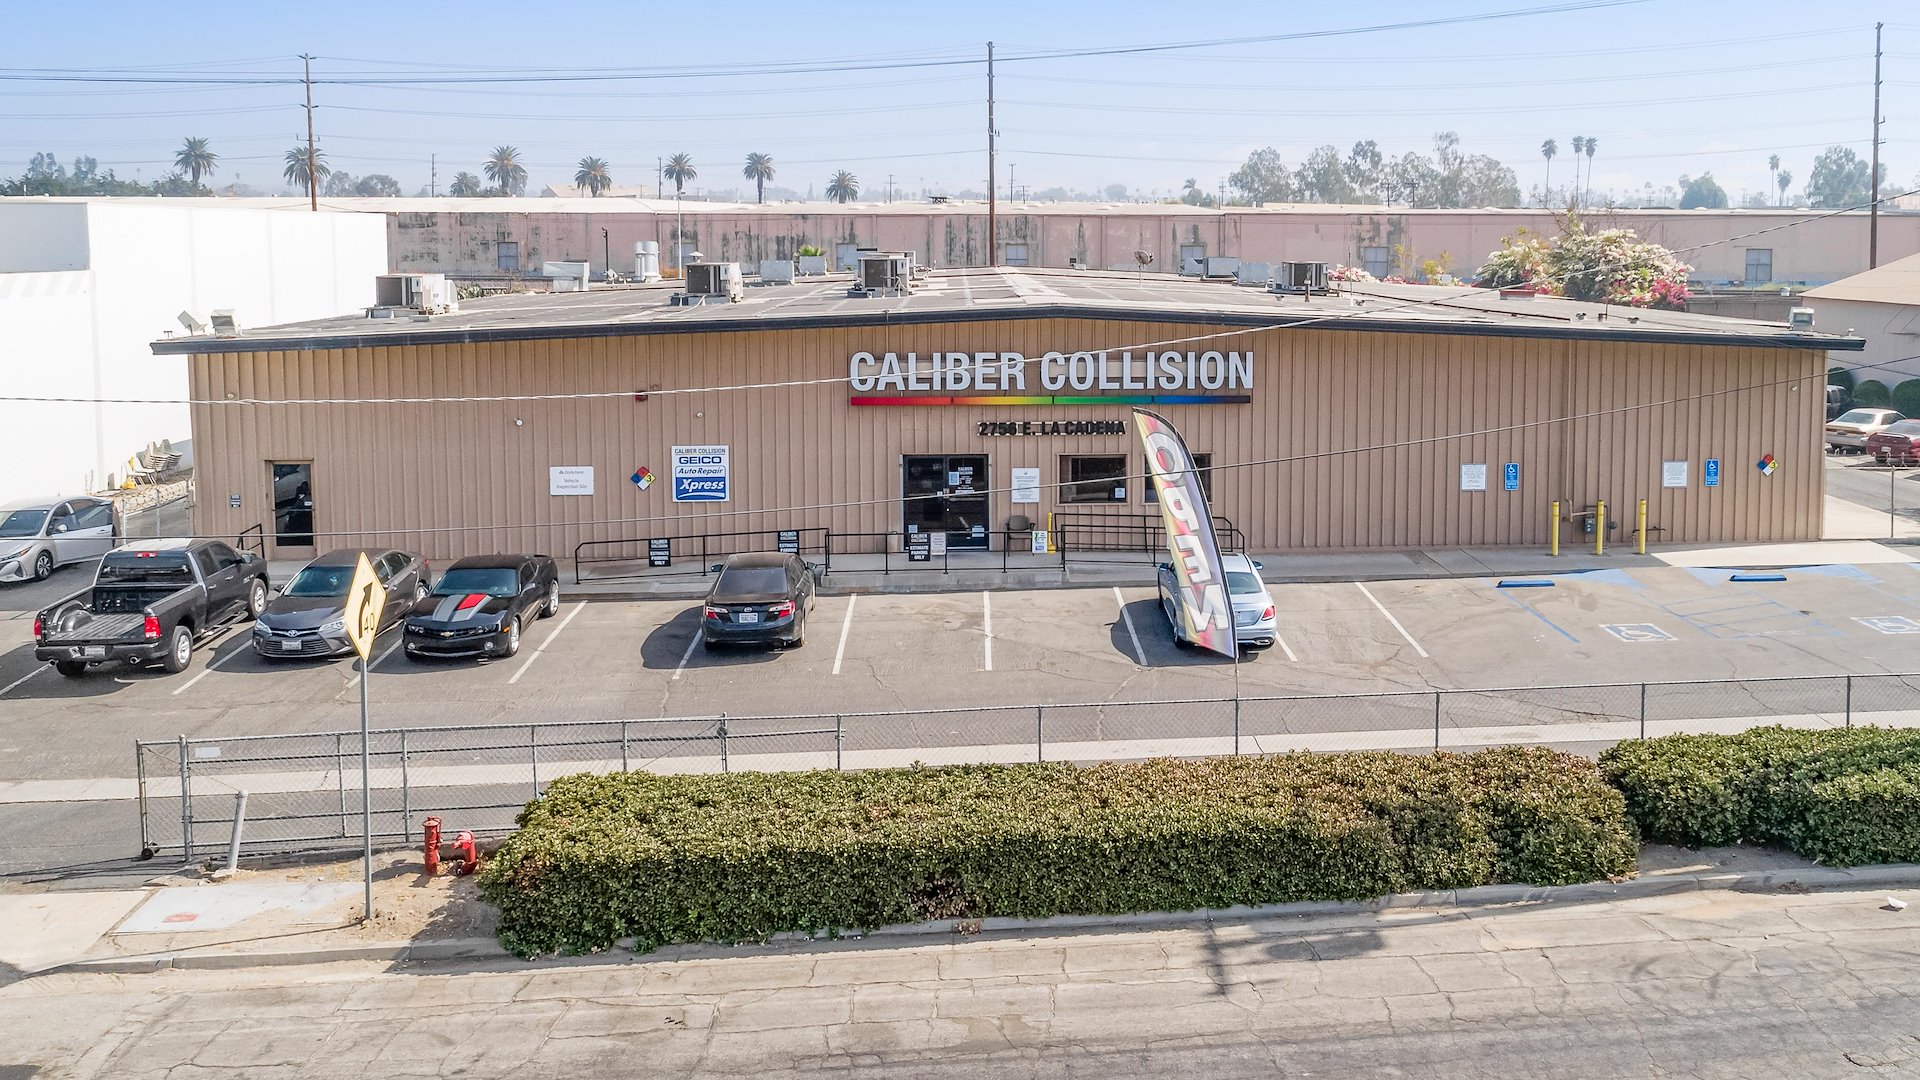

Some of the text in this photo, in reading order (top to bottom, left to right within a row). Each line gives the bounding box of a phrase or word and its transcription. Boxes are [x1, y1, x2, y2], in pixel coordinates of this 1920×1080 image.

[849, 350, 1254, 391] CALIBER COLLISION
[1041, 421, 1061, 436] LA
[1064, 421, 1126, 435] CADENA
[679, 456, 722, 464] GEICO
[646, 474, 652, 483] 3
[697, 467, 723, 475] Repair
[679, 478, 725, 493] Xpress
[364, 612, 375, 633] 40
